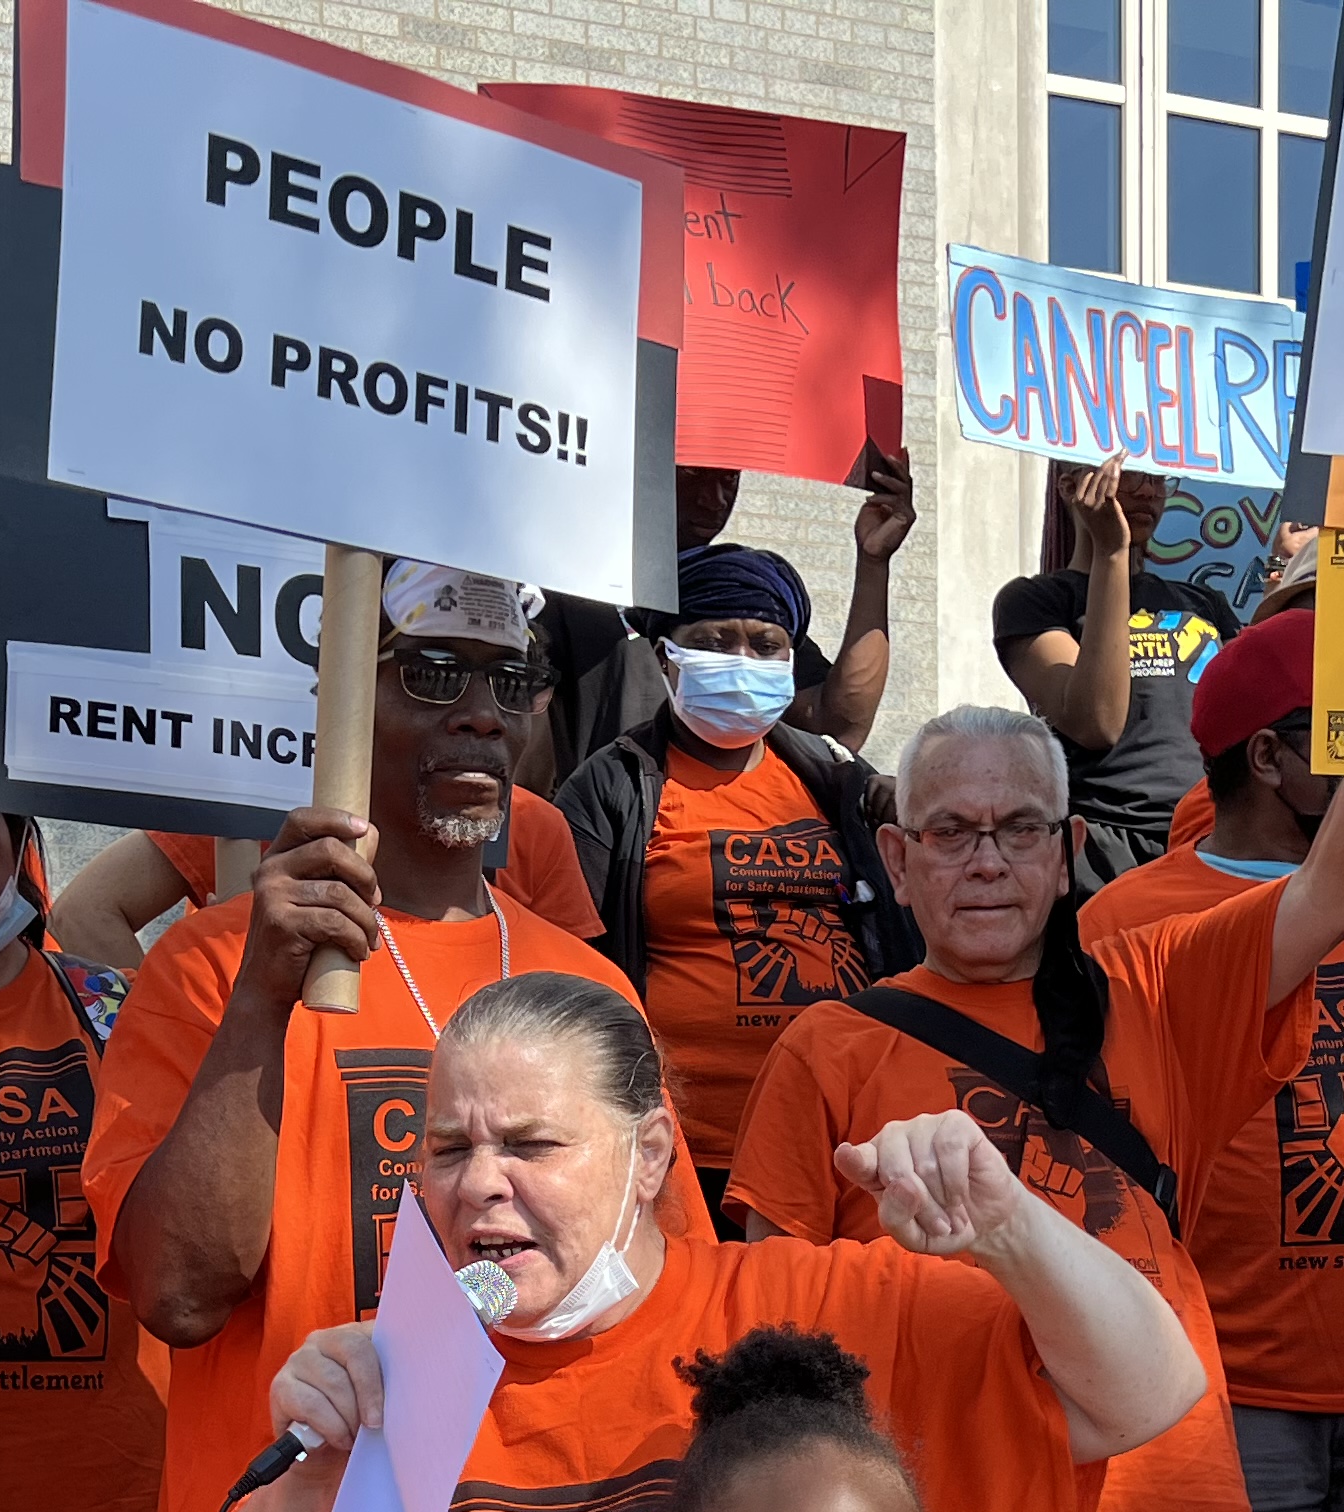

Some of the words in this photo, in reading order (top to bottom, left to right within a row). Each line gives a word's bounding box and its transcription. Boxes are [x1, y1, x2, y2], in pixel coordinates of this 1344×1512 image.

[205, 132, 552, 303] PEOPLE
[707, 262, 809, 335] back
[952, 265, 1219, 472] CANCEL
[138, 300, 244, 374] NO
[270, 333, 589, 467] PROFITS!!
[49, 694, 193, 749] RENT
[724, 834, 843, 867] CASA
[726, 881, 743, 892] for
[747, 881, 774, 893] Safe
[729, 867, 800, 881] Community
[735, 1012, 782, 1027] new
[22, 1125, 80, 1141] Action
[370, 1183, 400, 1201] for
[1278, 1250, 1328, 1271] new
